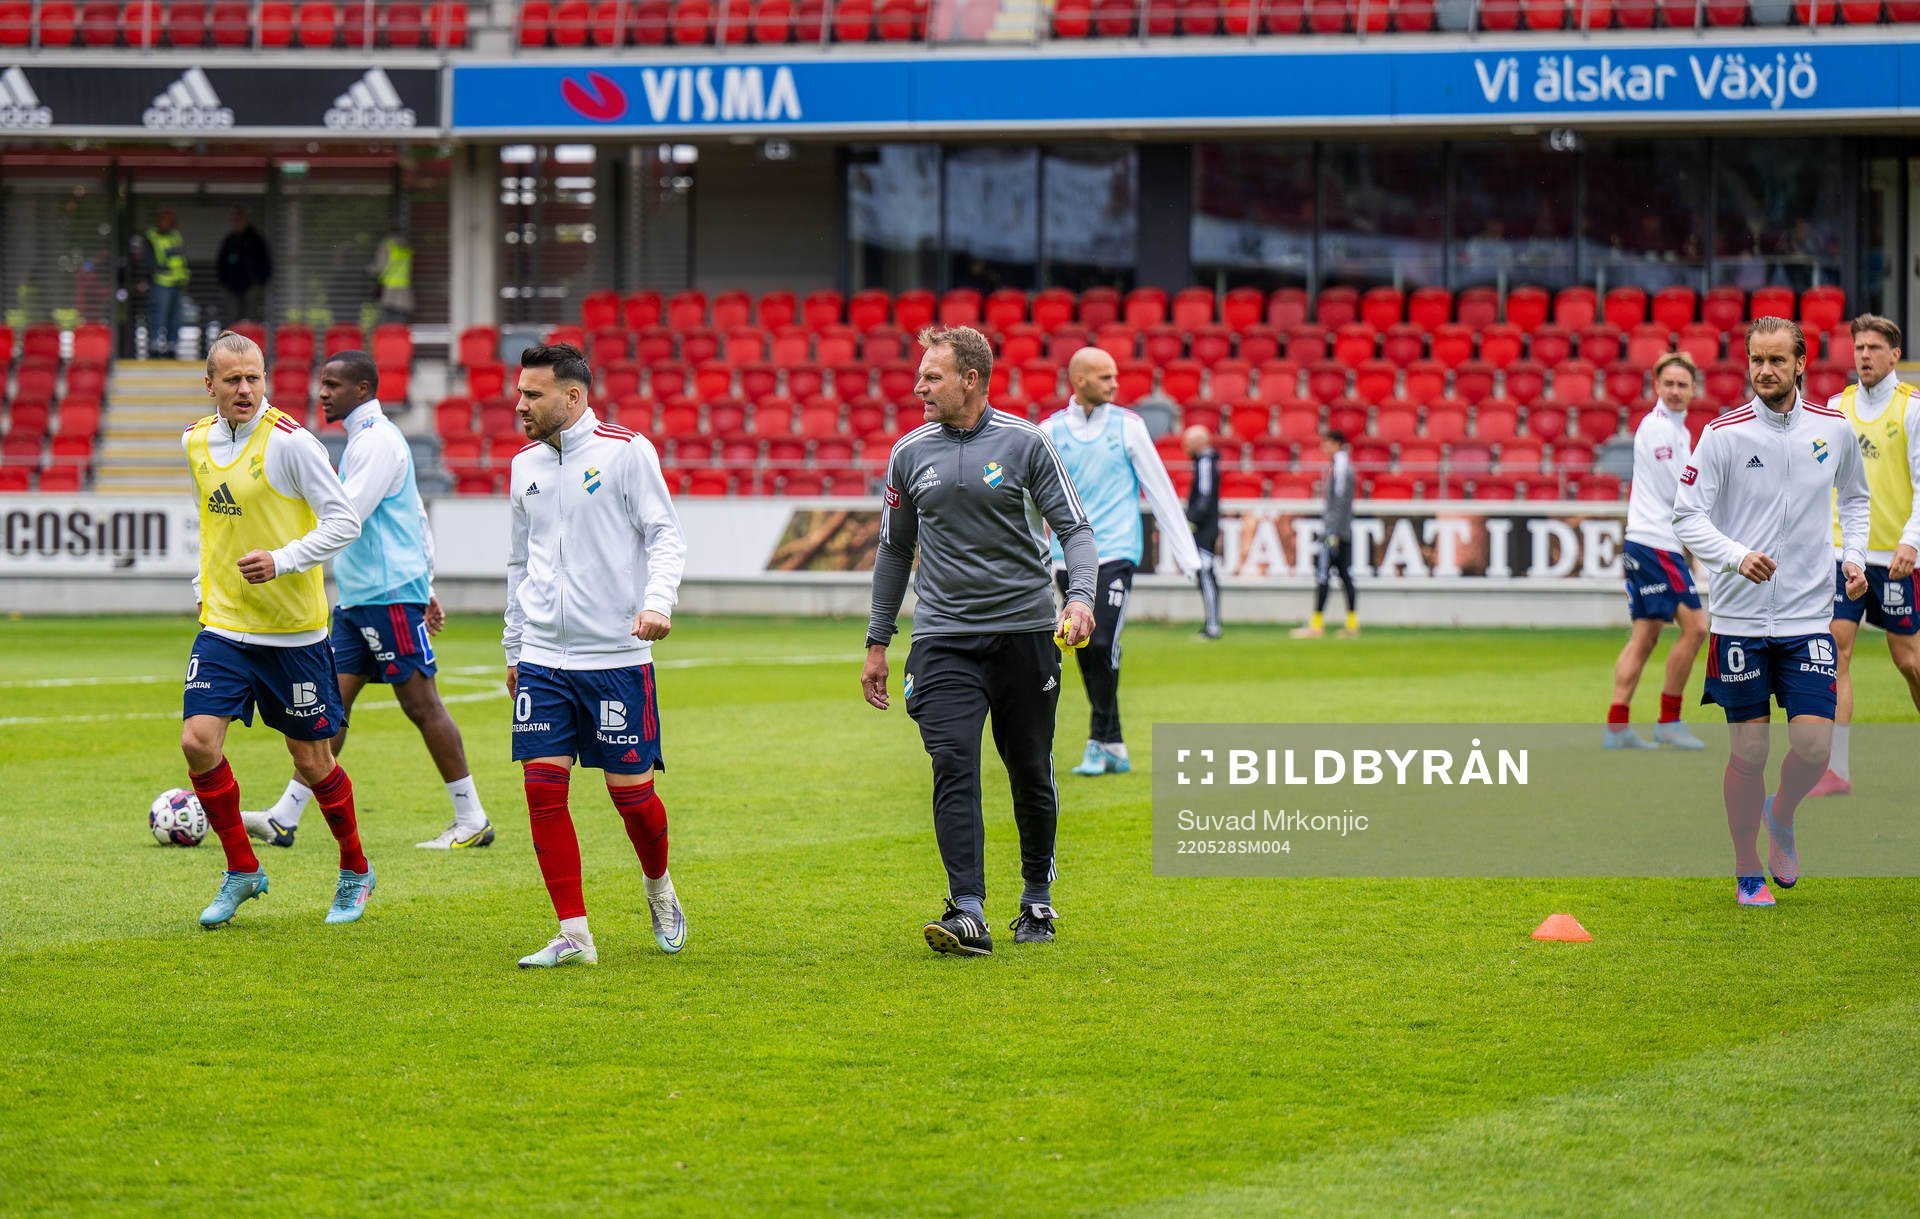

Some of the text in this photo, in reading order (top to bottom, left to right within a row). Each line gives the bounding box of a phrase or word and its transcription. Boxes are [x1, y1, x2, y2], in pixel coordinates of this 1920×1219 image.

[1474, 51, 1819, 110] Vi älskar Växjö
[641, 67, 802, 121] VISMA
[143, 107, 235, 129] adidas
[323, 107, 417, 129] adidas
[207, 502, 242, 516] adidas
[1486, 518, 1512, 577] I
[596, 730, 639, 745] BALCO
